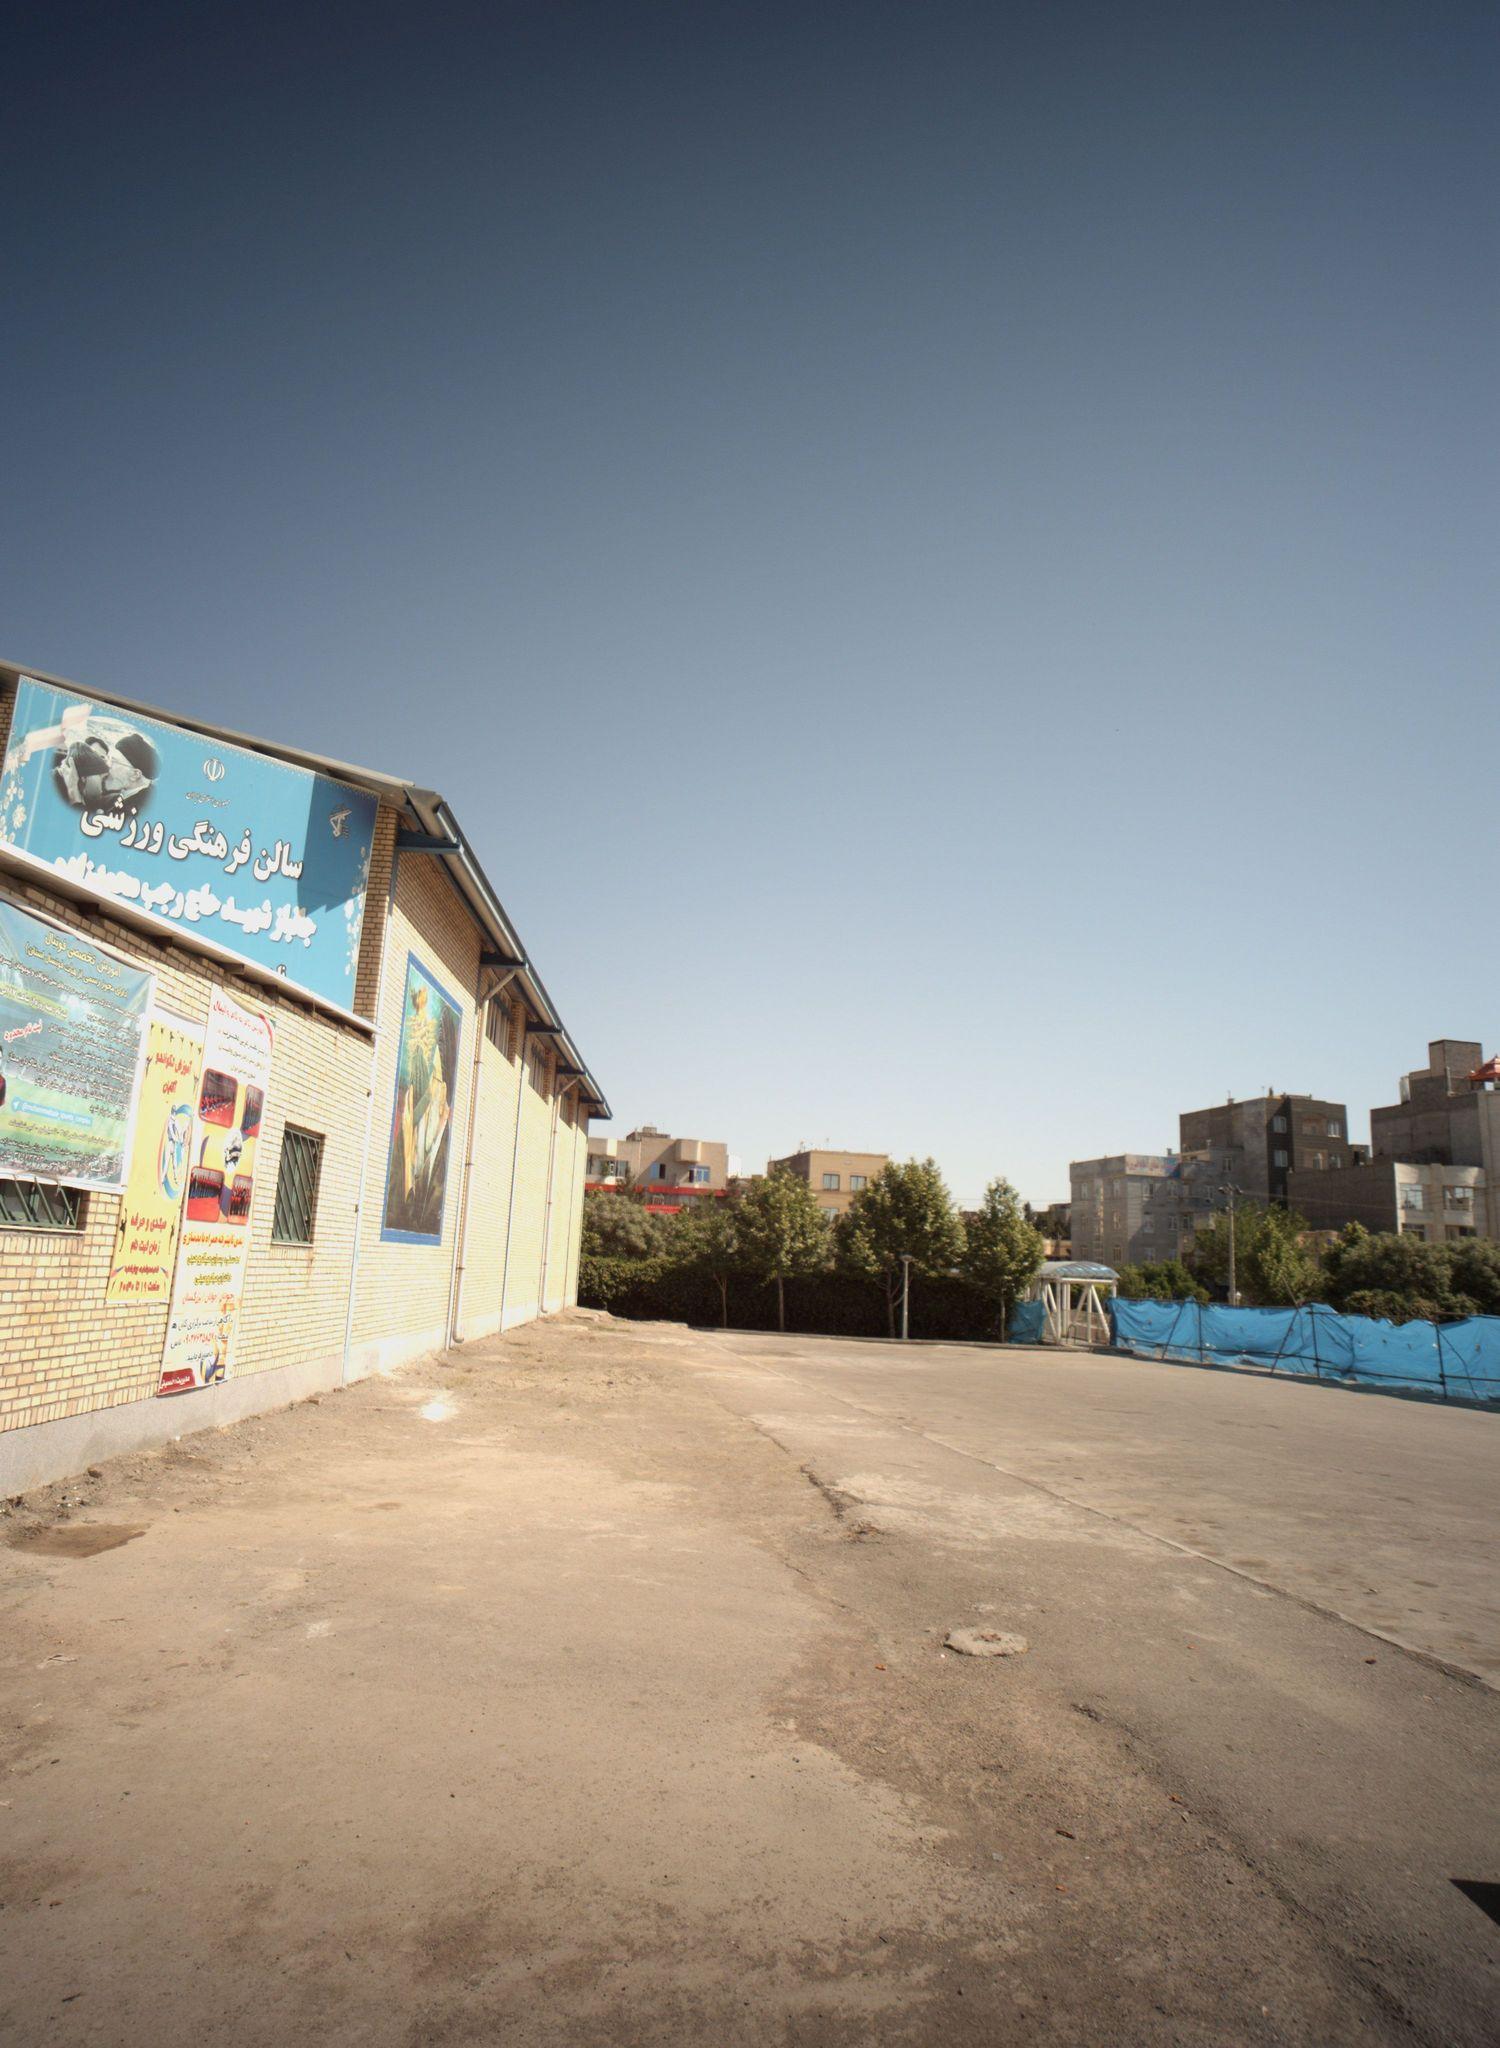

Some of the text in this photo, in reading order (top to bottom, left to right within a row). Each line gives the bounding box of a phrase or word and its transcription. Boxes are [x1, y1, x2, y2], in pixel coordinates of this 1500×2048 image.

[80, 797, 303, 881] سالن فرهنگی ورزشی
[141, 881, 185, 919] رجب
[184, 882, 221, 922] حاج
